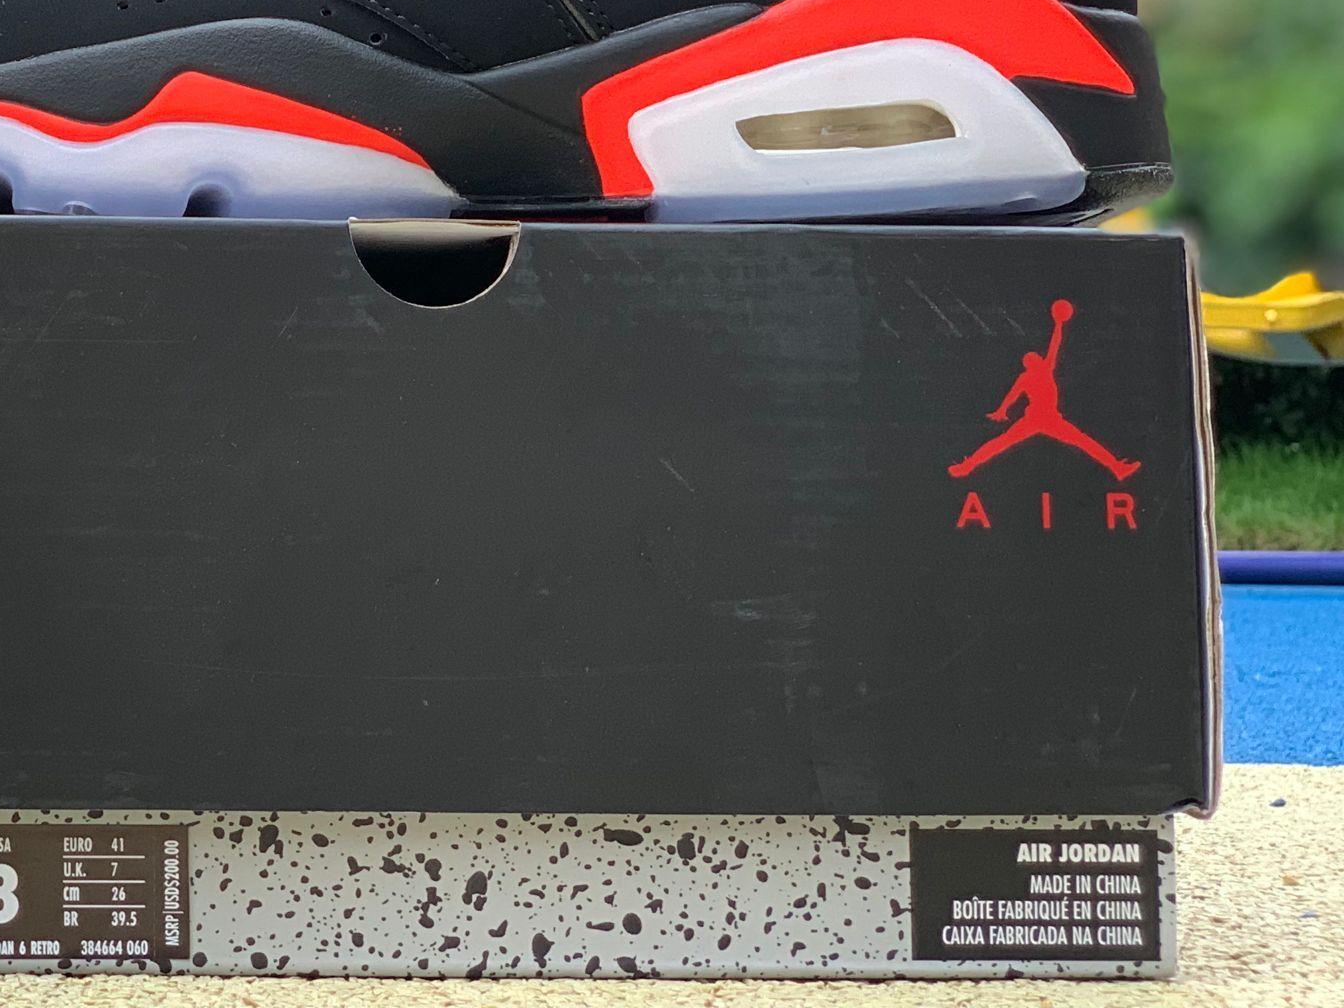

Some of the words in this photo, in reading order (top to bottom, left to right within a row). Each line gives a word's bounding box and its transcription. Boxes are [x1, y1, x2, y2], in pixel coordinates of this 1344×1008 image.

[956, 491, 1138, 529] AIR
[63, 837, 93, 853] EURO
[111, 837, 124, 853] 41
[1016, 842, 1053, 863] AIR
[1058, 842, 1140, 863] JORDAN
[63, 862, 87, 877] U.K.
[111, 862, 119, 877] 7
[1030, 874, 1071, 894] MADE
[1075, 874, 1091, 894] IN
[1096, 874, 1142, 894] CHINA
[111, 886, 126, 902] 26
[952, 896, 994, 920] BOÎTE
[998, 896, 1069, 921] FABRIQUÉ
[1073, 900, 1091, 920] EN
[1096, 900, 1142, 920] CHINA
[63, 911, 79, 927] BR
[111, 911, 137, 927] 39.5
[942, 925, 985, 945] CAIXA
[989, 925, 1068, 945] FABRICADA
[1072, 925, 1093, 945] NA
[1097, 925, 1143, 945] CHINA
[19, 940, 27, 956] 6
[30, 940, 61, 956] RETRO
[81, 940, 123, 956] 384664
[126, 940, 149, 956] 060
